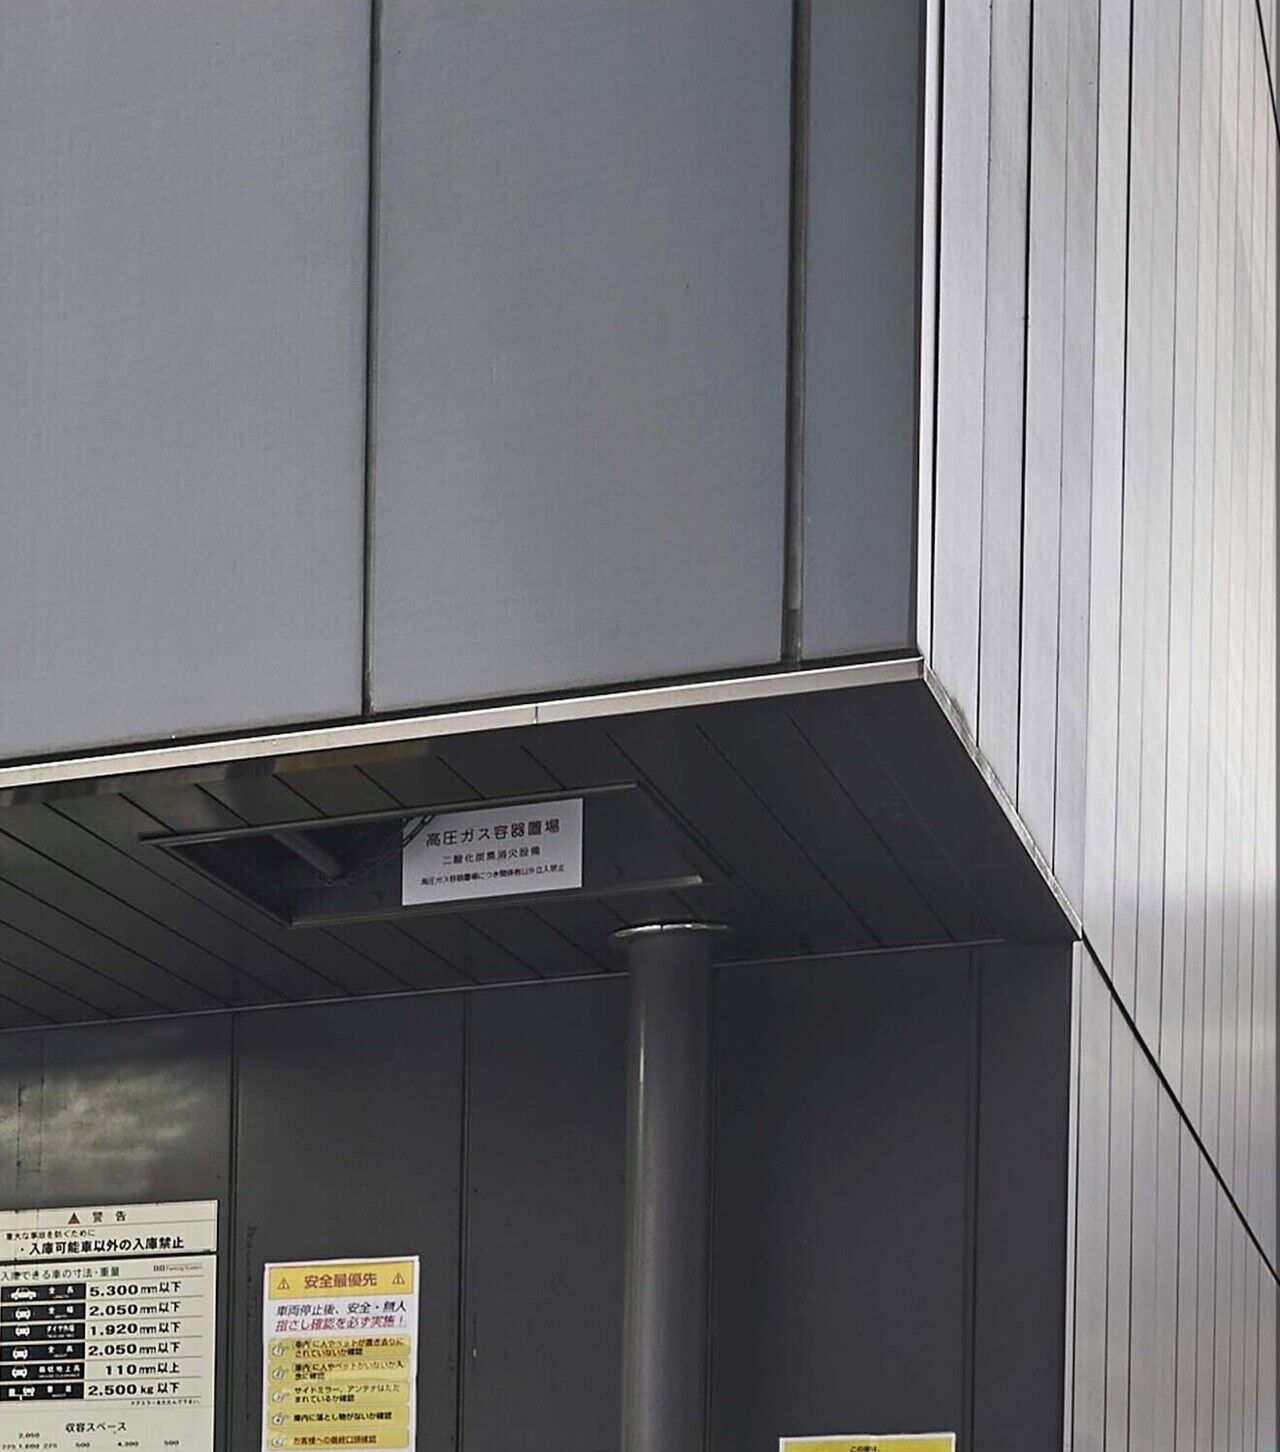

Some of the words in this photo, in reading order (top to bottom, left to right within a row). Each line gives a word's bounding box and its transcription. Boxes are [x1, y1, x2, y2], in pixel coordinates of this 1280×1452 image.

[425, 818, 561, 848] 高圧ガス容器置場
[442, 846, 541, 865] 二酸化炭素消火設備
[304, 1273, 377, 1289] 安全最優先
[65, 1421, 128, 1434] 収容スペース
